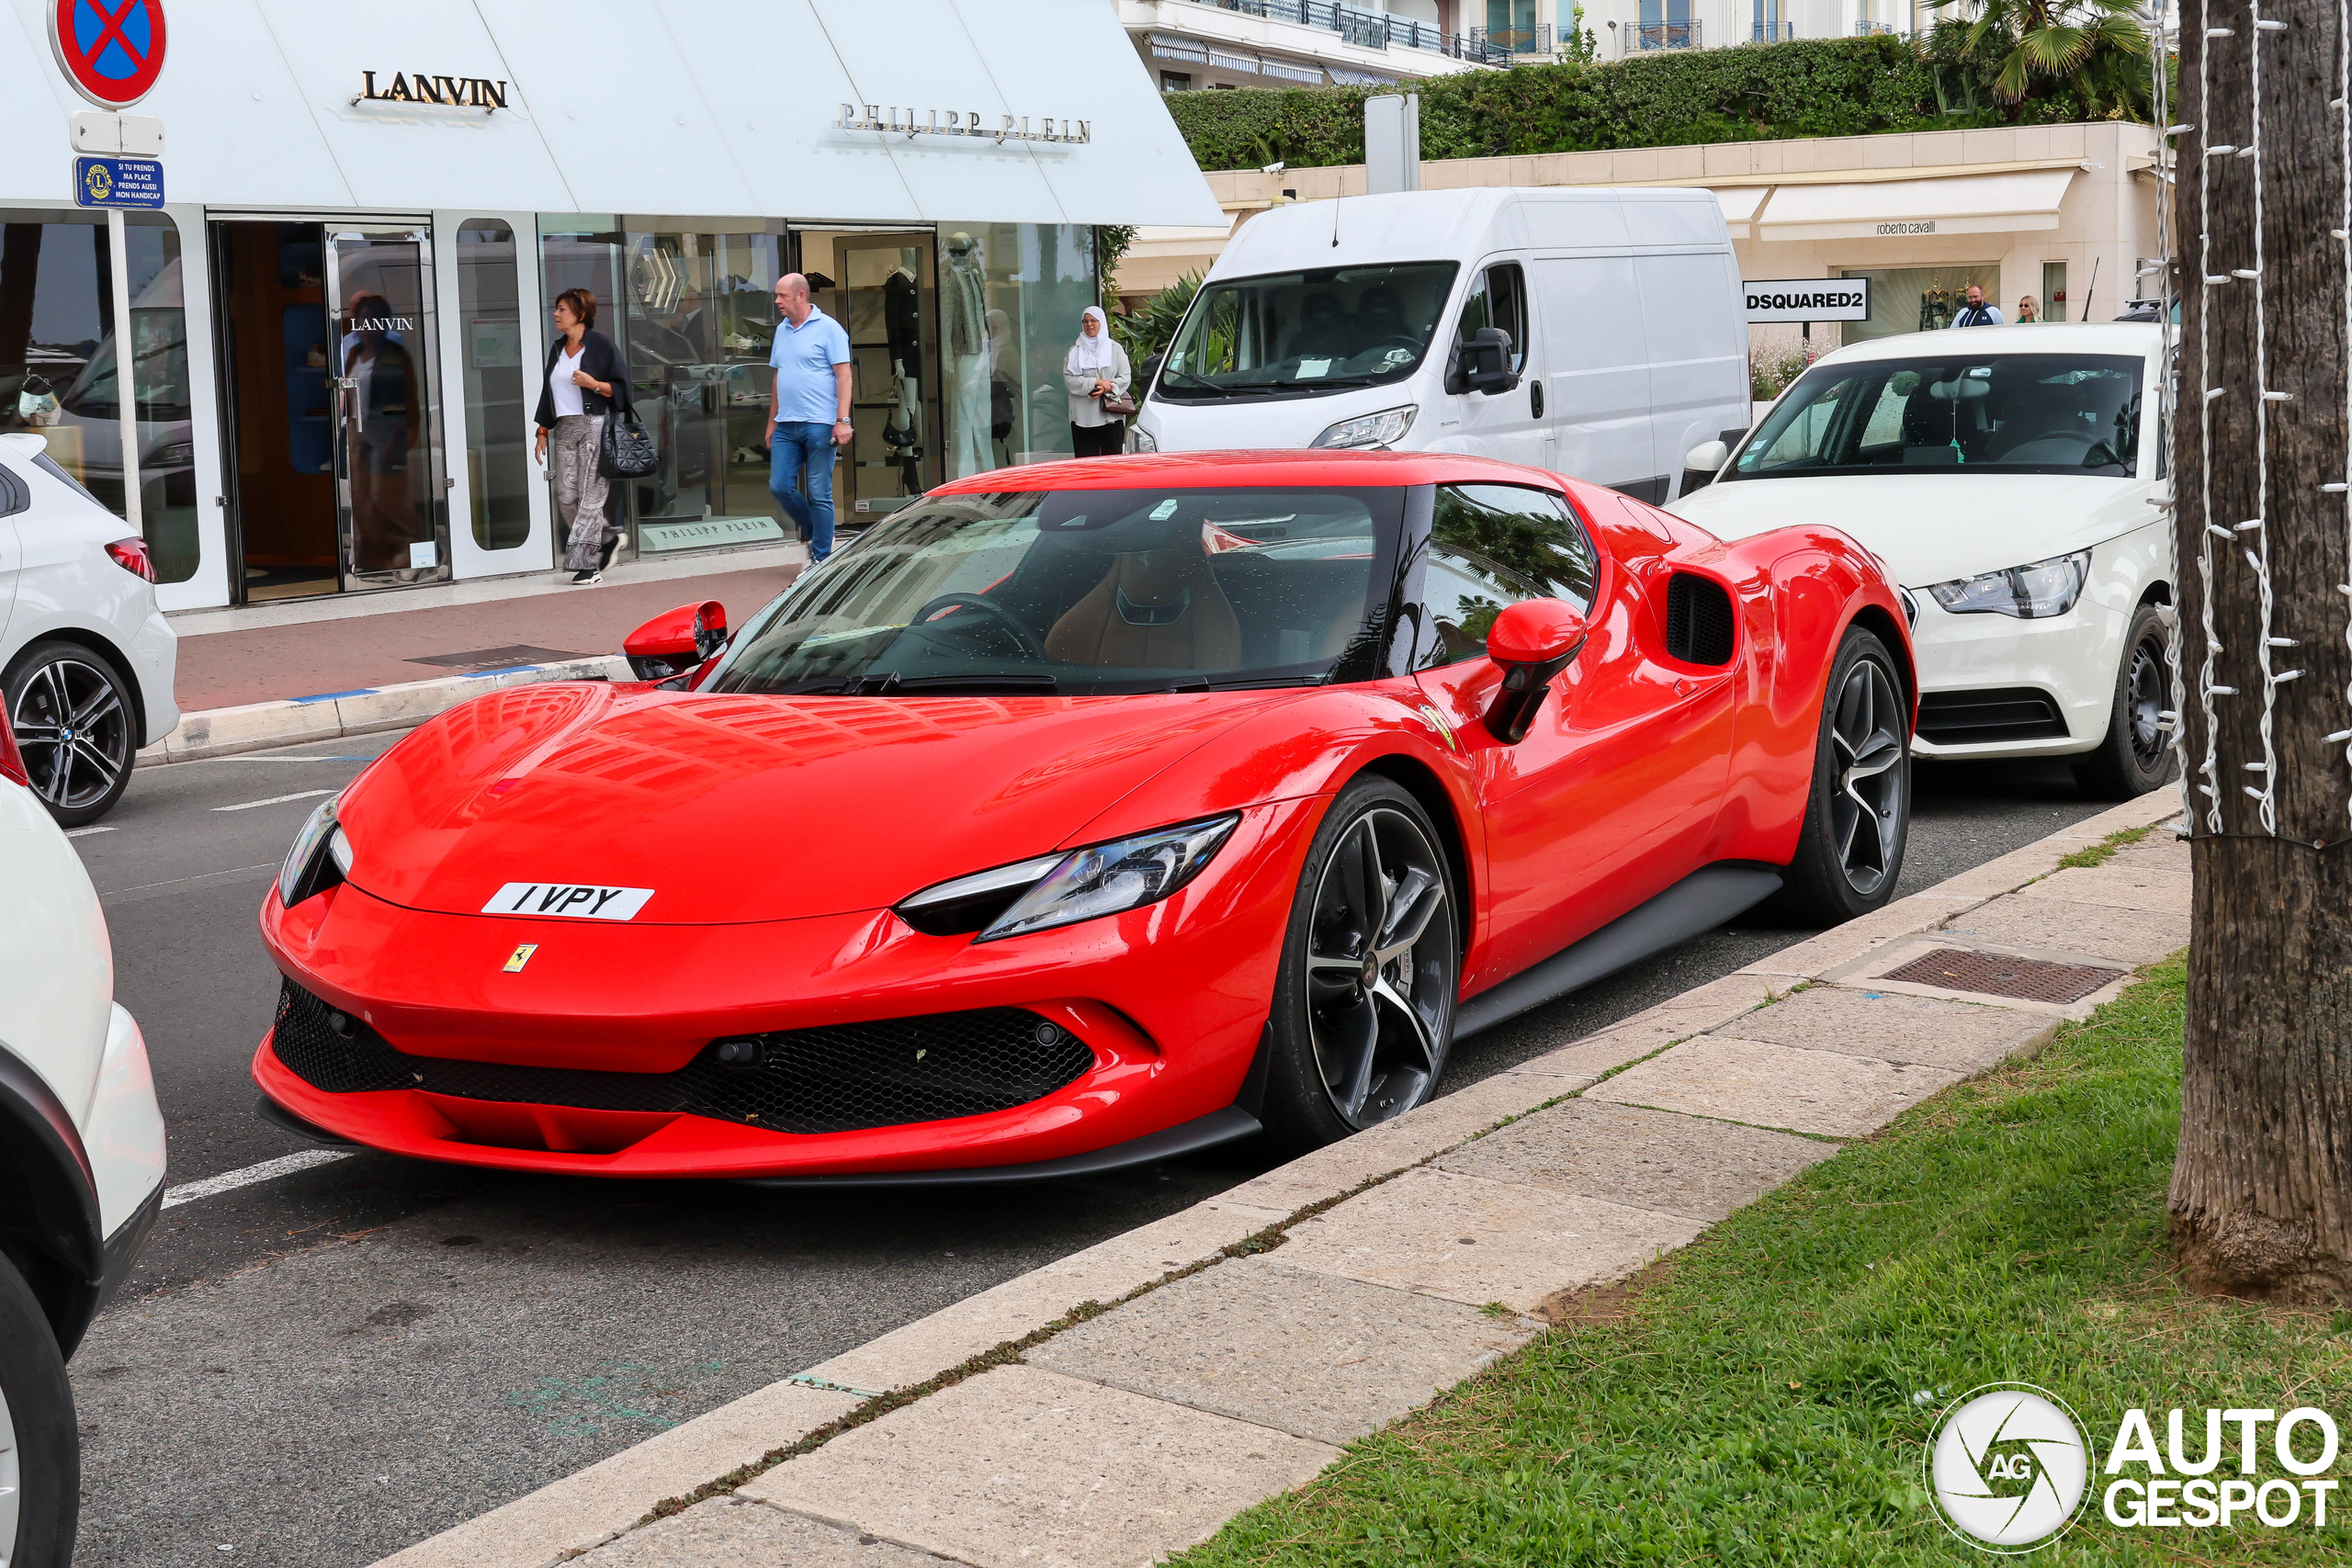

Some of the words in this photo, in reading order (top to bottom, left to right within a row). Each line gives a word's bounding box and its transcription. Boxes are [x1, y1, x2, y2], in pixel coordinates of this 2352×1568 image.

[360, 71, 508, 107] LANVIN
[838, 103, 980, 136] PHILIPP
[1000, 114, 1091, 143] PLEIN
[90, 165, 107, 174] LIONS
[96, 175, 104, 187] L
[130, 191, 161, 199] HANDICAP
[1877, 222, 1907, 234] roberto
[1908, 220, 1936, 233] cavalli
[1747, 292, 1863, 310] DSQUARED2
[350, 318, 413, 331] LANVIN
[660, 525, 718, 539] PHILIPP
[725, 520, 768, 533] PLEIN
[537, 886, 624, 915] VPY
